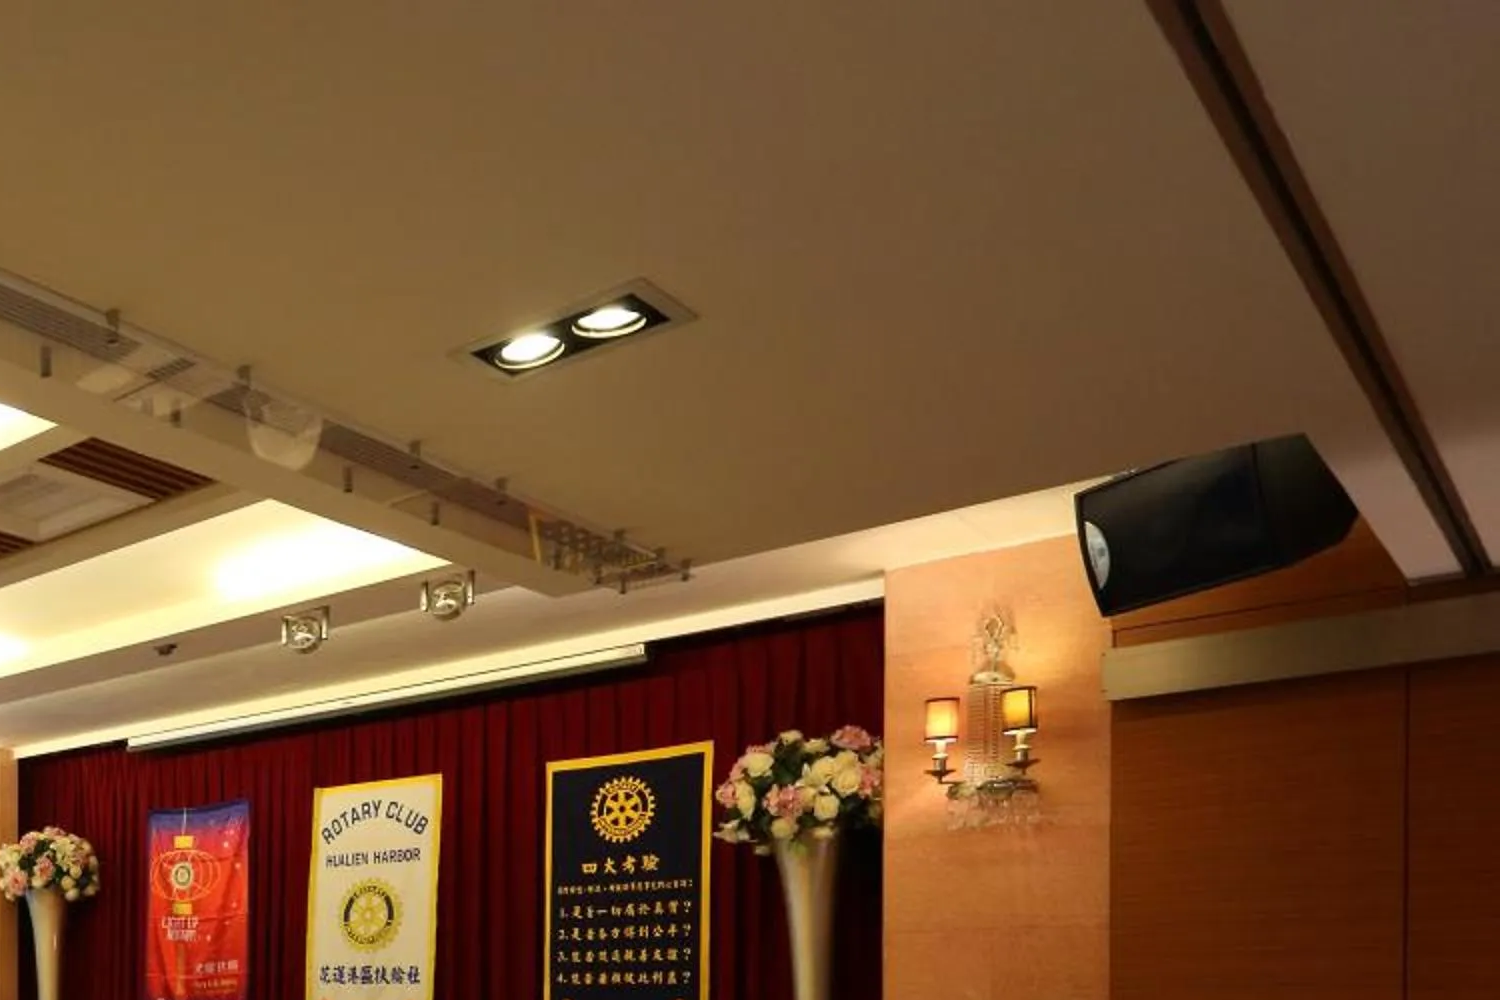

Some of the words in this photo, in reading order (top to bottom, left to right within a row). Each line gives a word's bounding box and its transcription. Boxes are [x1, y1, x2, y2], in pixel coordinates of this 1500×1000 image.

[322, 800, 382, 845] ROTARY
[385, 801, 429, 835] CLUB
[326, 853, 368, 868] HUALIEN
[373, 847, 421, 865] HARBOR
[581, 854, 660, 875] 四大考驗
